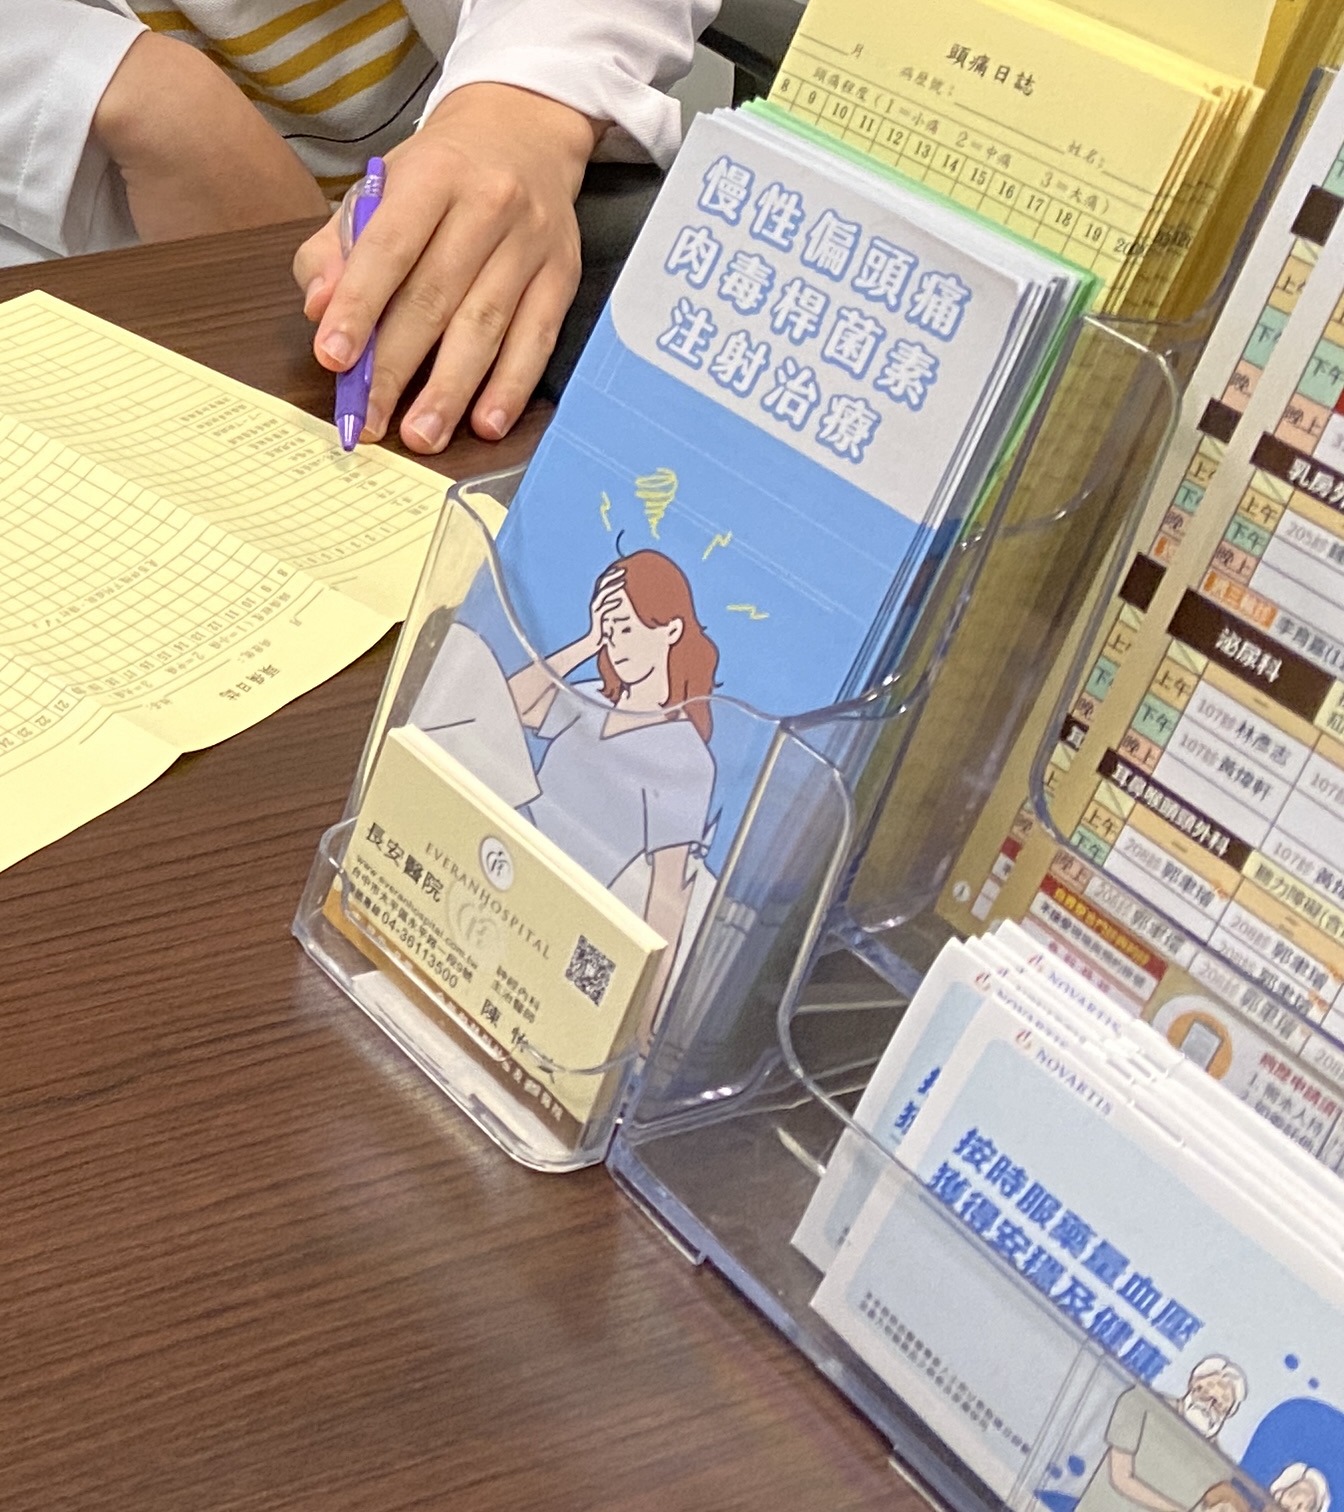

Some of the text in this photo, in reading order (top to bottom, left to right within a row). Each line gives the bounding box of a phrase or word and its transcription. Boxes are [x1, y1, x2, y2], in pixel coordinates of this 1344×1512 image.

[851, 44, 864, 58] 月
[946, 43, 1036, 97] 頭痛日誌
[781, 78, 790, 92] 8
[808, 91, 817, 104] 9
[832, 102, 848, 119] 10
[859, 115, 875, 132] 11
[886, 128, 904, 145] 12
[914, 140, 931, 158] 13
[942, 154, 959, 172] 14
[970, 167, 987, 185] 15
[998, 181, 1016, 199] 16
[1026, 194, 1045, 213] 17
[1055, 209, 1073, 227] 18
[1085, 223, 1103, 242] 19
[697, 155, 971, 342] 慢性偏頭痛
[664, 226, 940, 411] 肉毒桿菌素
[657, 297, 882, 464] 注射治療
[1230, 517, 1267, 550] 下午
[1238, 496, 1279, 524] 上午
[1156, 669, 1192, 697] 上午
[1215, 626, 1283, 683] 泌尿科
[1142, 703, 1174, 733] 下午
[1085, 808, 1119, 837] 上午
[365, 822, 445, 903] 長安醫院
[381, 910, 459, 989] 04-36113500
[1036, 1049, 1111, 1116] NOVARTIS
[925, 1160, 1172, 1384] 獲得安穩及健康
[951, 1126, 1206, 1352] 按時服藥量血壓
